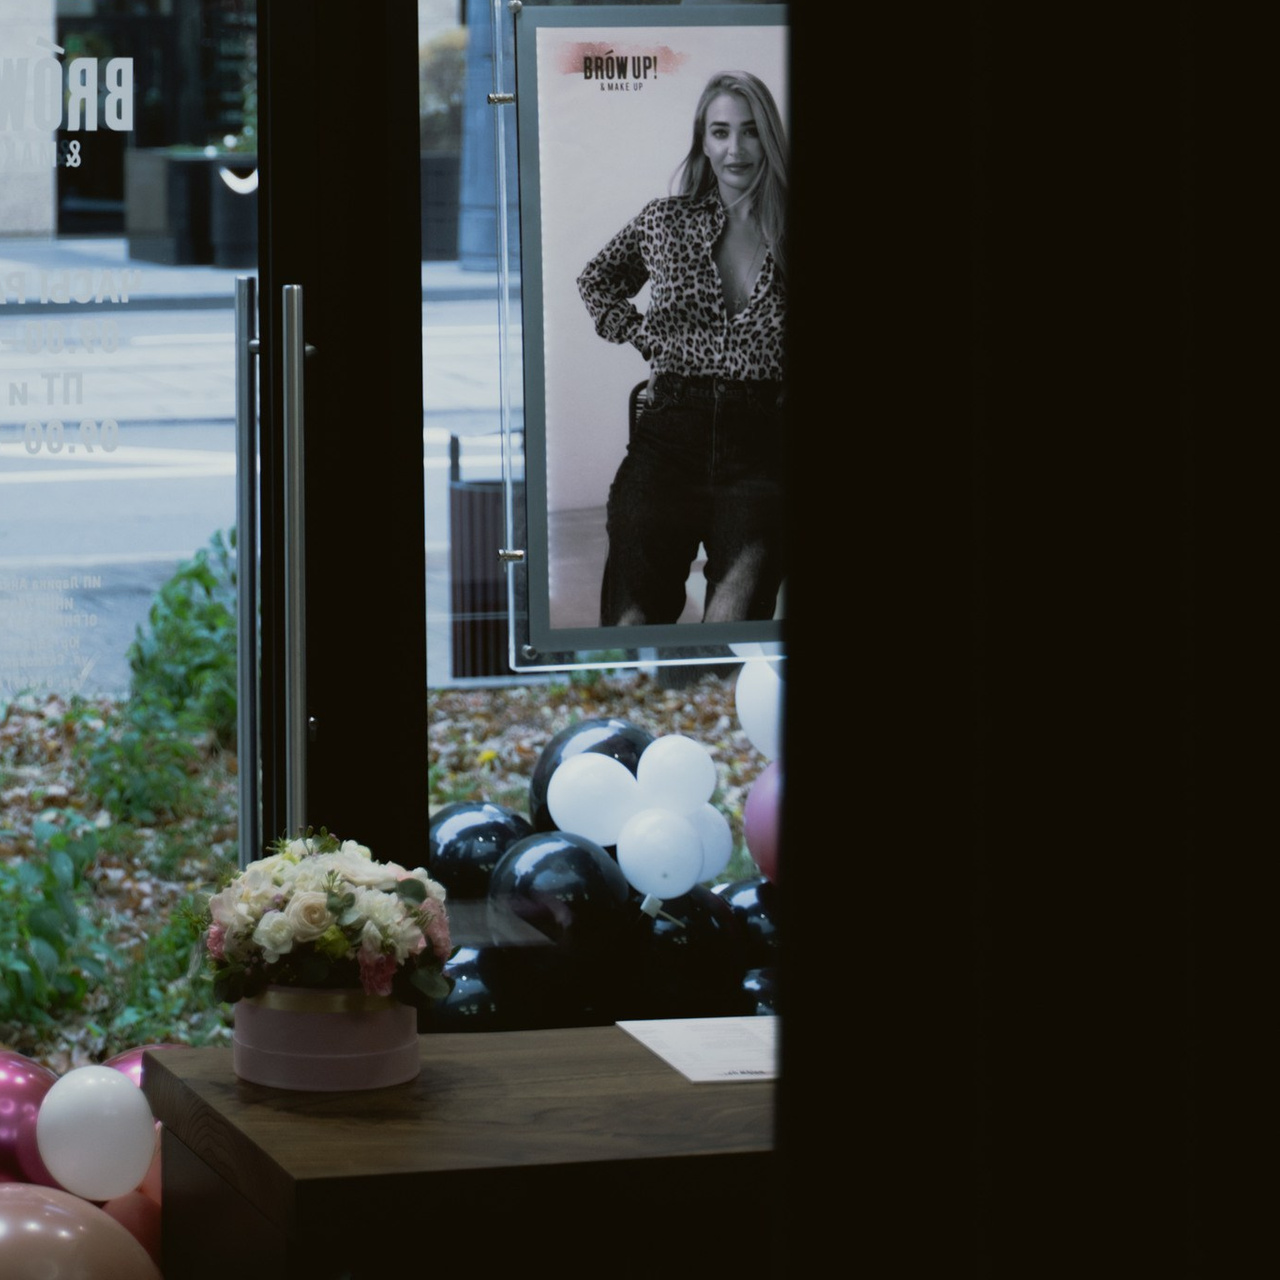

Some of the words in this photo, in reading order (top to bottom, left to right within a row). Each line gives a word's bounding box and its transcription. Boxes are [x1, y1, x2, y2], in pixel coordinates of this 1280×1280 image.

[583, 49, 628, 80] BRÓW
[632, 56, 658, 80] UP!
[607, 83, 630, 91] MAKE
[633, 82, 643, 91] UP
